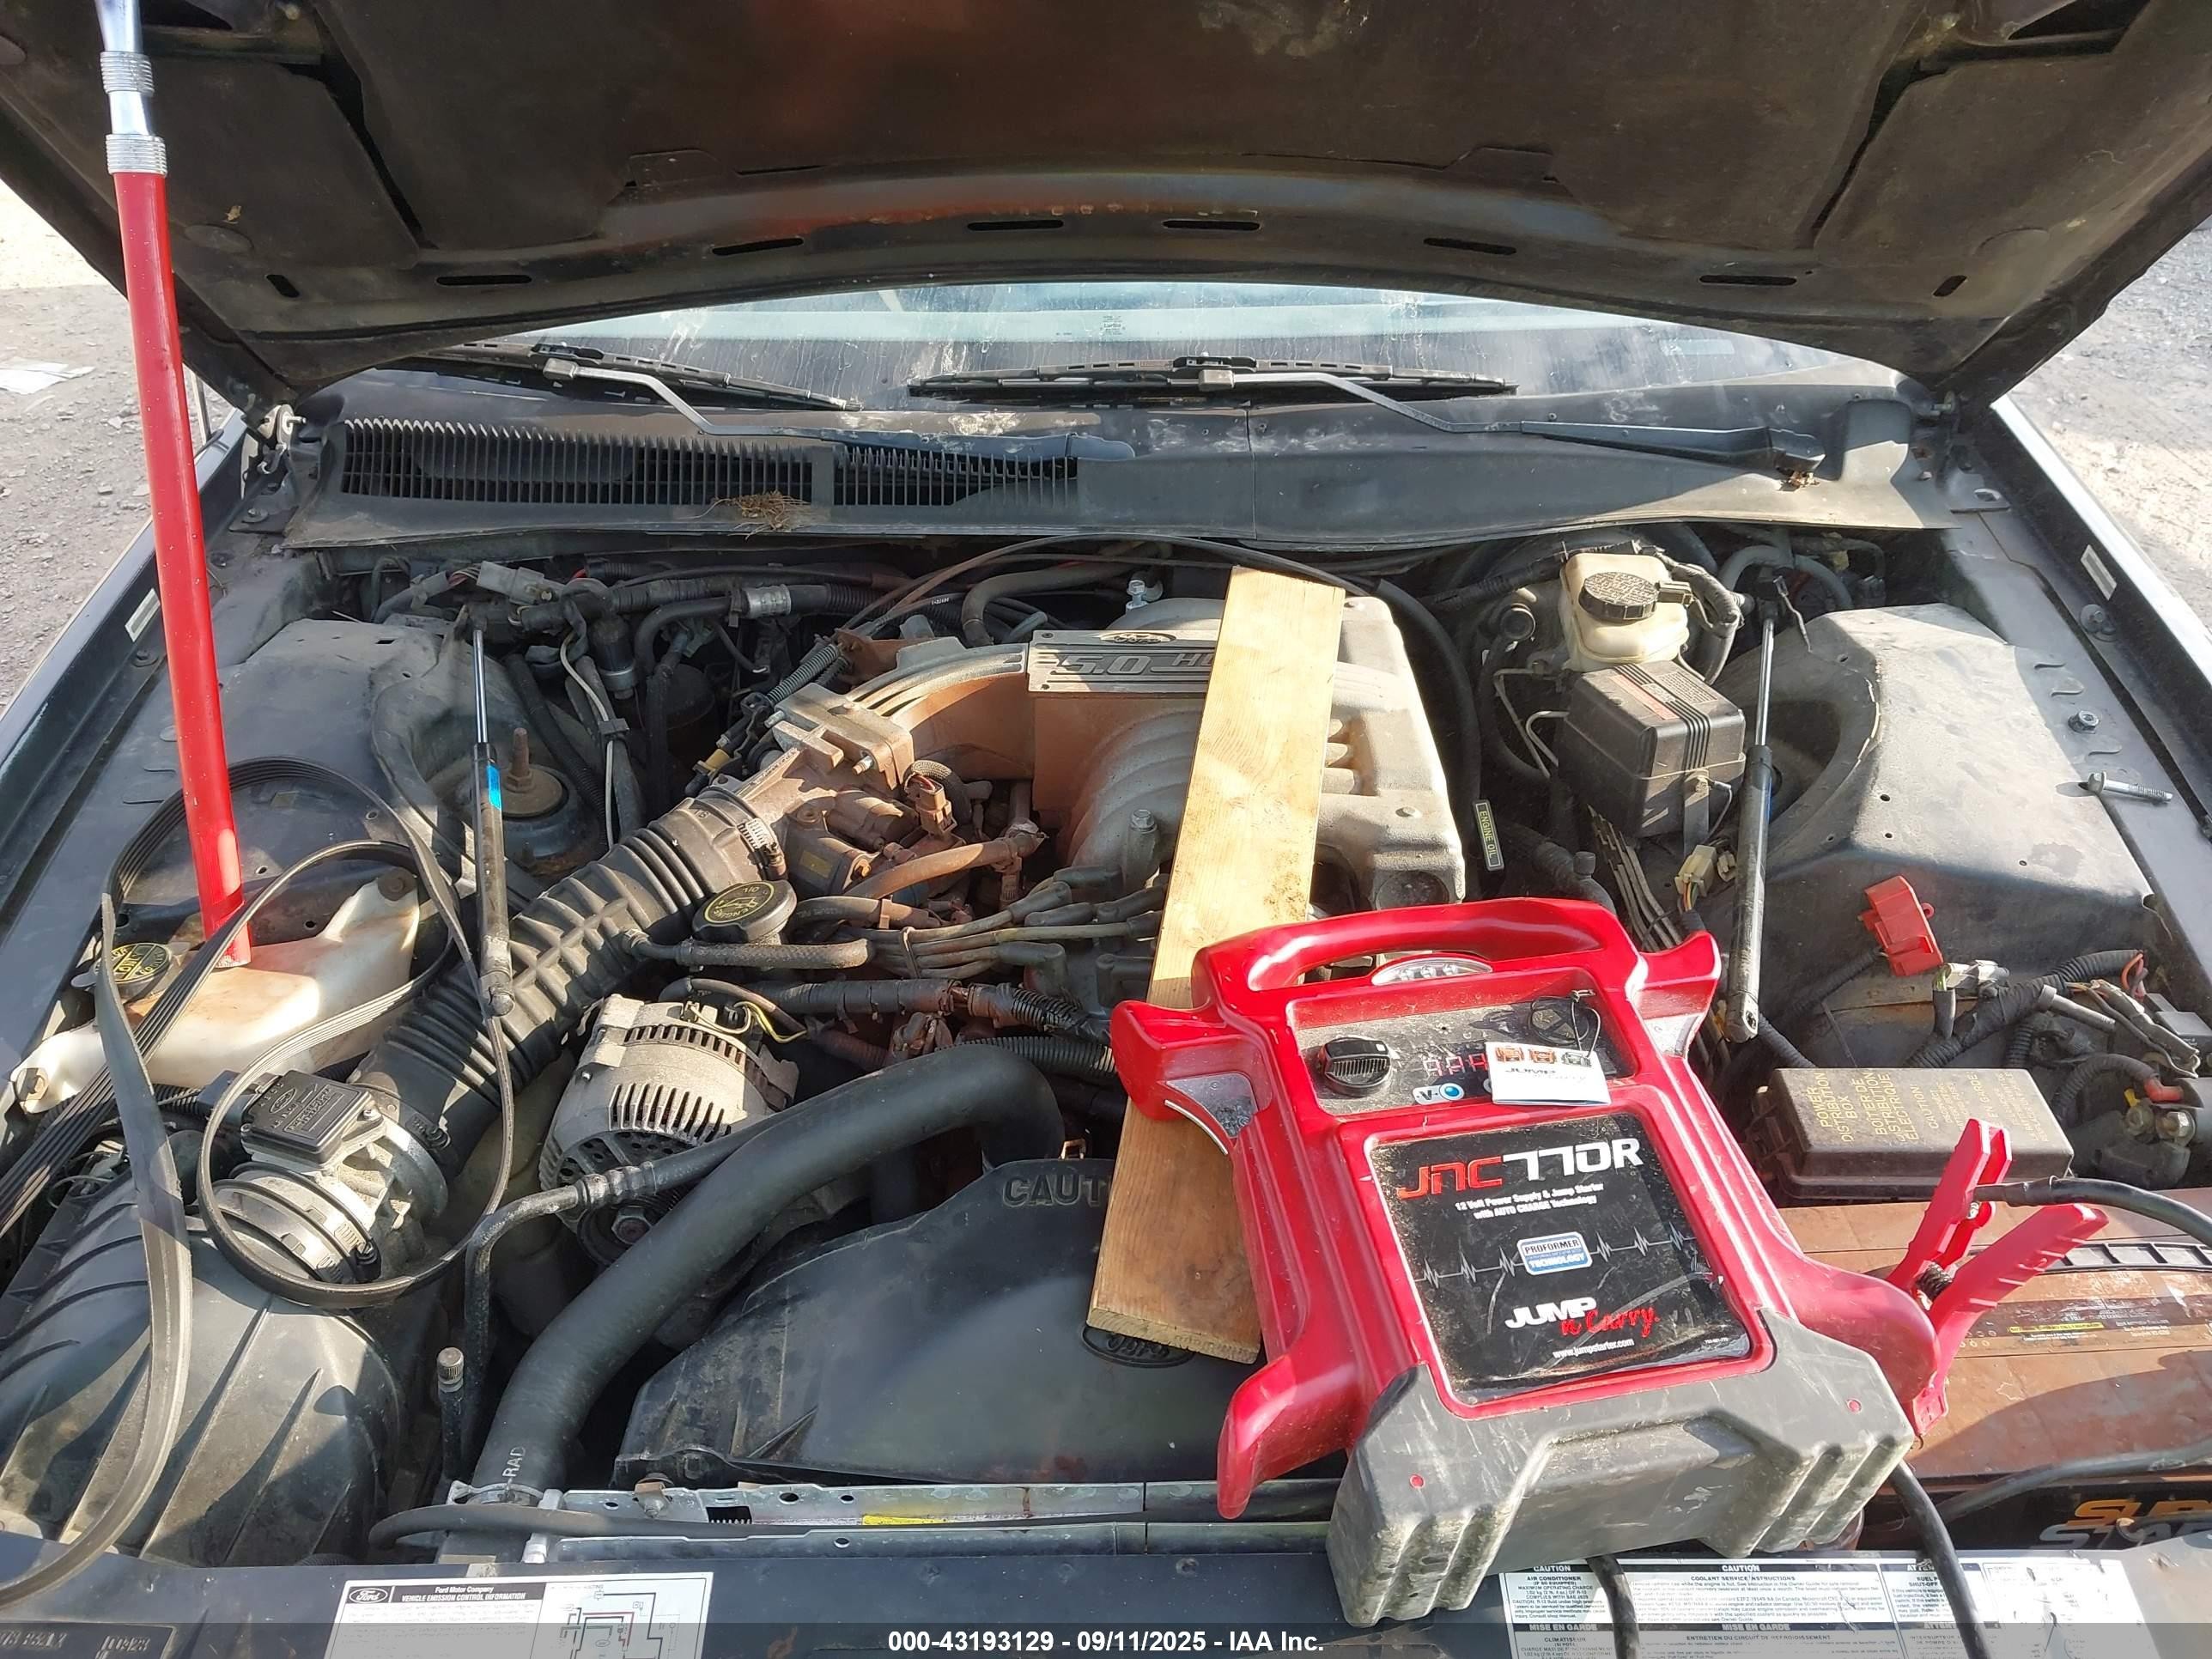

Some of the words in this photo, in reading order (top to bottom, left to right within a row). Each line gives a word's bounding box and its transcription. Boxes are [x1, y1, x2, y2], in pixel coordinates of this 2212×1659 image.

[1061, 655, 1152, 676] 5.0
[1480, 810, 1494, 842] ENGINE
[1487, 844, 1497, 859] OIL
[1420, 1090, 1433, 1101] V
[1806, 1086, 1832, 1127] POWER
[1814, 1073, 1854, 1142] DISTRIBUTION
[1838, 1095, 1857, 1119] BOX
[1003, 1171, 1110, 1207] CAUT
[1455, 1202, 1468, 1211] 12
[1467, 1200, 1486, 1210] Volt
[1485, 1196, 1512, 1206] Power
[1512, 1192, 1542, 1203] Supply
[1542, 1190, 1551, 1199] &
[1551, 1188, 1575, 1199] Jump
[1575, 1182, 1604, 1194] Starter
[1474, 1209, 1495, 1219] with
[1494, 1206, 1516, 1217] AUTO
[1516, 1201, 1552, 1213] CHARGE
[1551, 1195, 1597, 1208] Technology
[1524, 1239, 1580, 1255] PROFORMER
[1528, 1252, 1586, 1268] TECHNOLOGY
[1504, 1297, 1597, 1329] JUMP
[1552, 1338, 1635, 1359] www.jumpstarter.com
[502, 1446, 526, 1477] RAD
[355, 1588, 382, 1602] Ford
